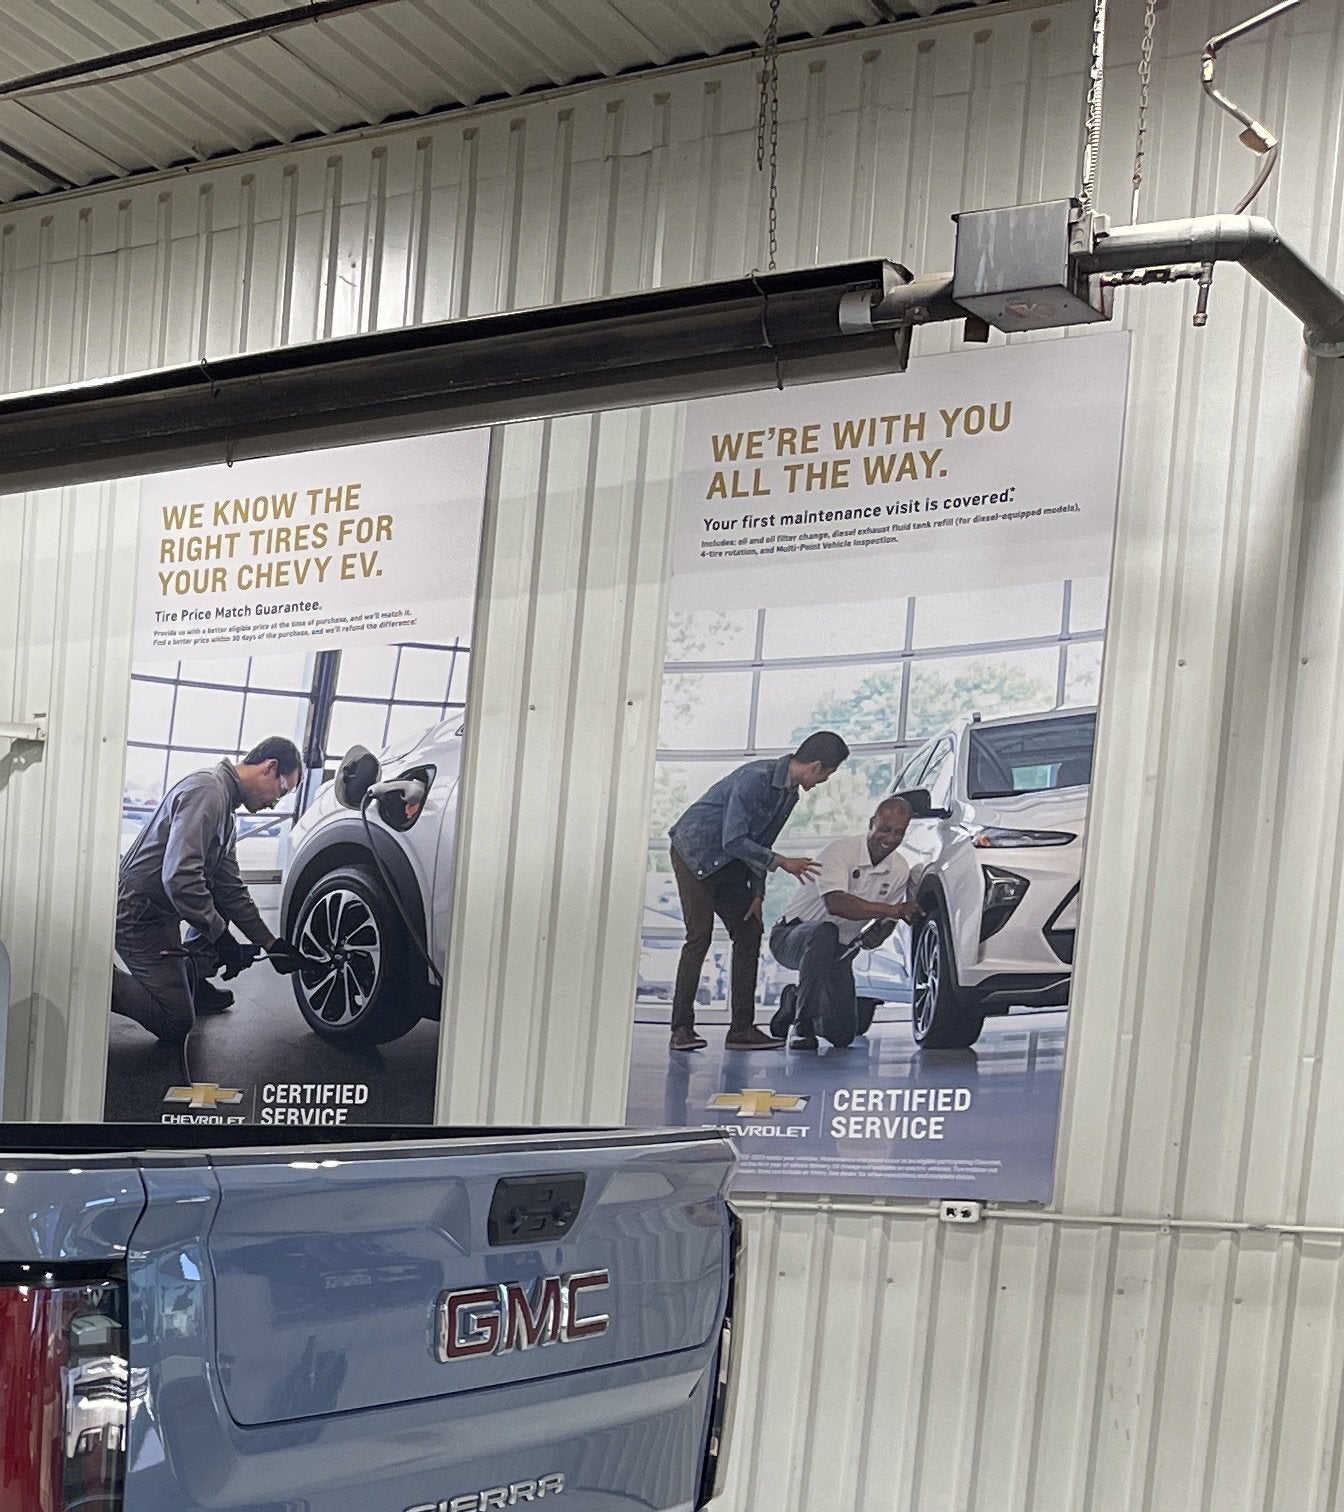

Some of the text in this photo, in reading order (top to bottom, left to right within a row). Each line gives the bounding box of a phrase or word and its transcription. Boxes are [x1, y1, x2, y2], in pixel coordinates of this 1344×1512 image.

[711, 401, 1013, 464] WE'RE WITH YOU
[705, 448, 948, 500] ALL THE WAY.
[162, 483, 362, 531] WE KNOW THE
[703, 517, 738, 532] Your
[742, 514, 776, 529] first
[780, 506, 882, 526] maintenance
[886, 500, 920, 516] visit
[925, 497, 938, 512] is
[159, 514, 394, 565] RIGHT TIRES FOR
[749, 536, 764, 545] and
[891, 522, 911, 533] fluid
[158, 550, 384, 596] YOUR CHEVY EV.
[155, 600, 323, 622] Tire Price Match Guarantee.
[262, 1083, 369, 1104] CERTIFIED
[833, 1087, 972, 1113] CERTIFIED
[260, 1107, 349, 1126] SERVICE
[702, 1124, 811, 1138] EVROLET
[830, 1115, 945, 1140] SERVICE
[435, 1268, 610, 1364] GMC
